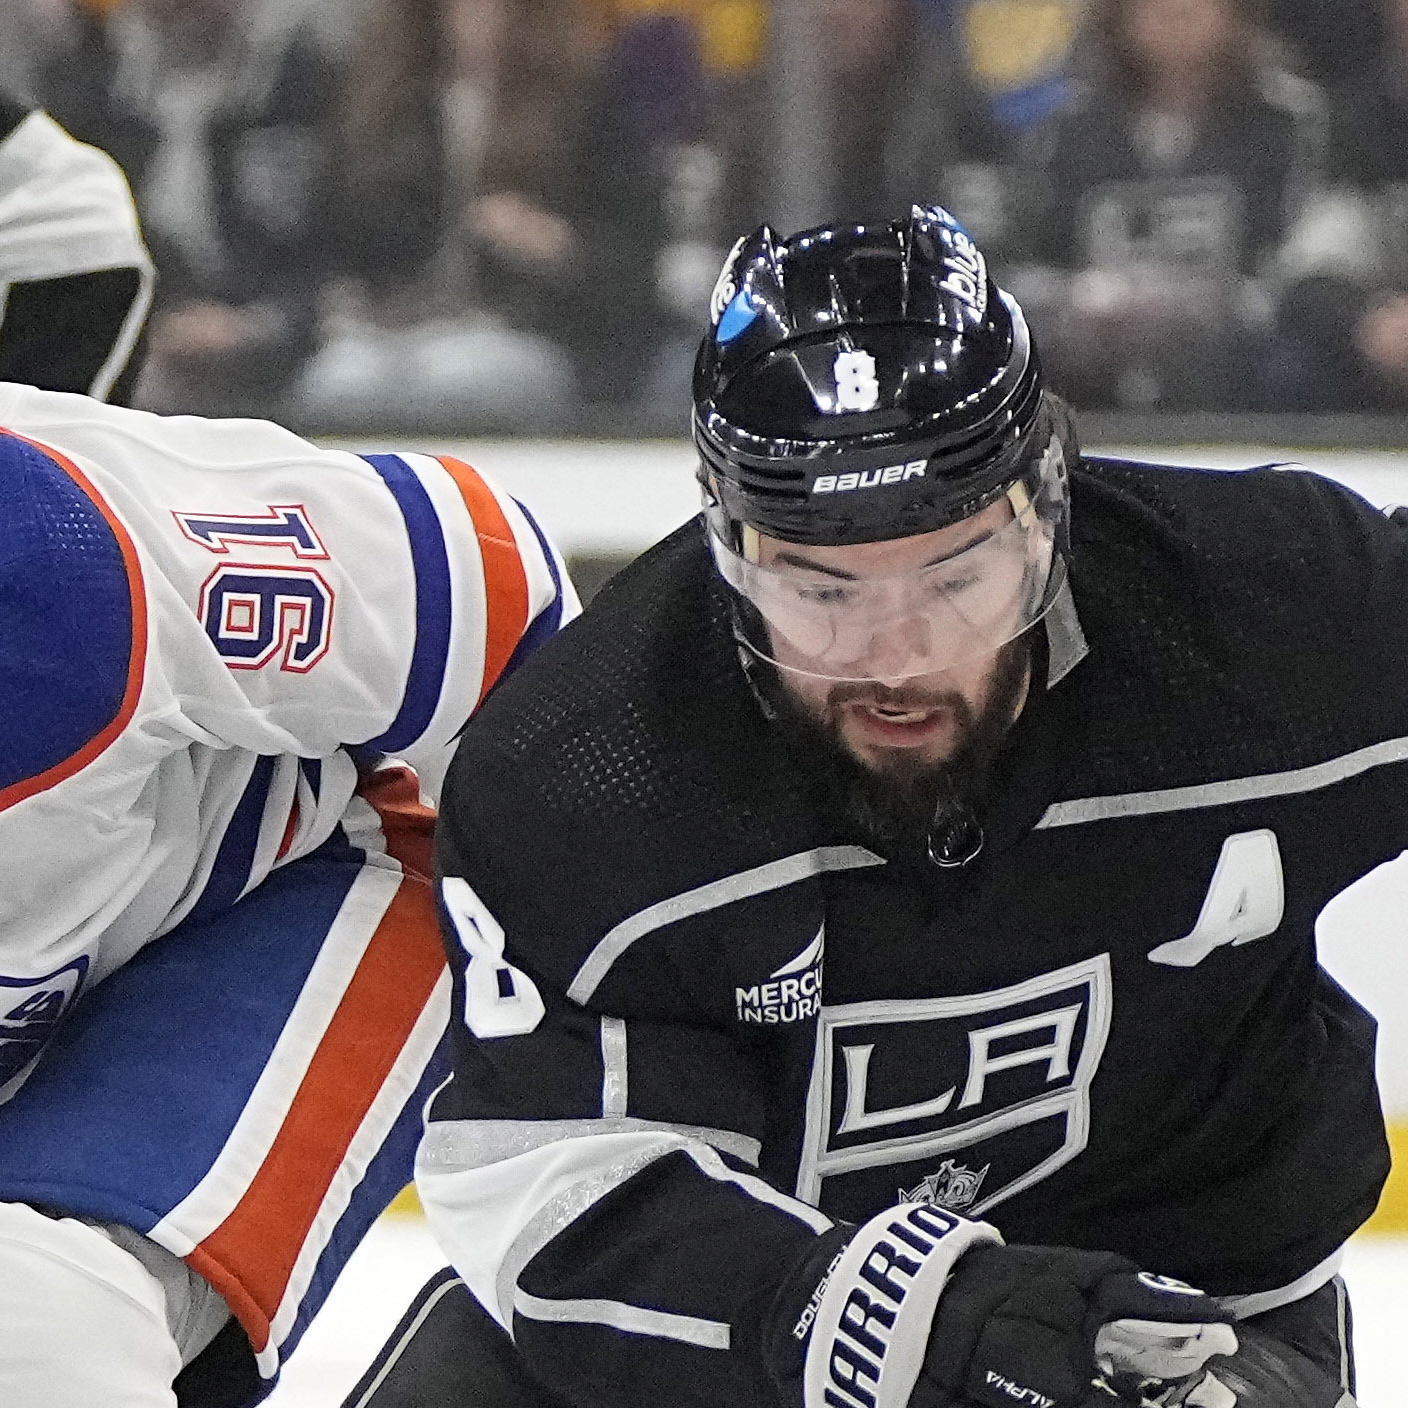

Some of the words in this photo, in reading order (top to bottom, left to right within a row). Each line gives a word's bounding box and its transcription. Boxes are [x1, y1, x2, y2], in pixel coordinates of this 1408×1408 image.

[833, 350, 879, 410] 8
[812, 458, 928, 495] BAUER
[170, 504, 336, 674] 91
[441, 876, 546, 1039] 8
[1147, 829, 1285, 967] A
[837, 1001, 1085, 1136] LA
